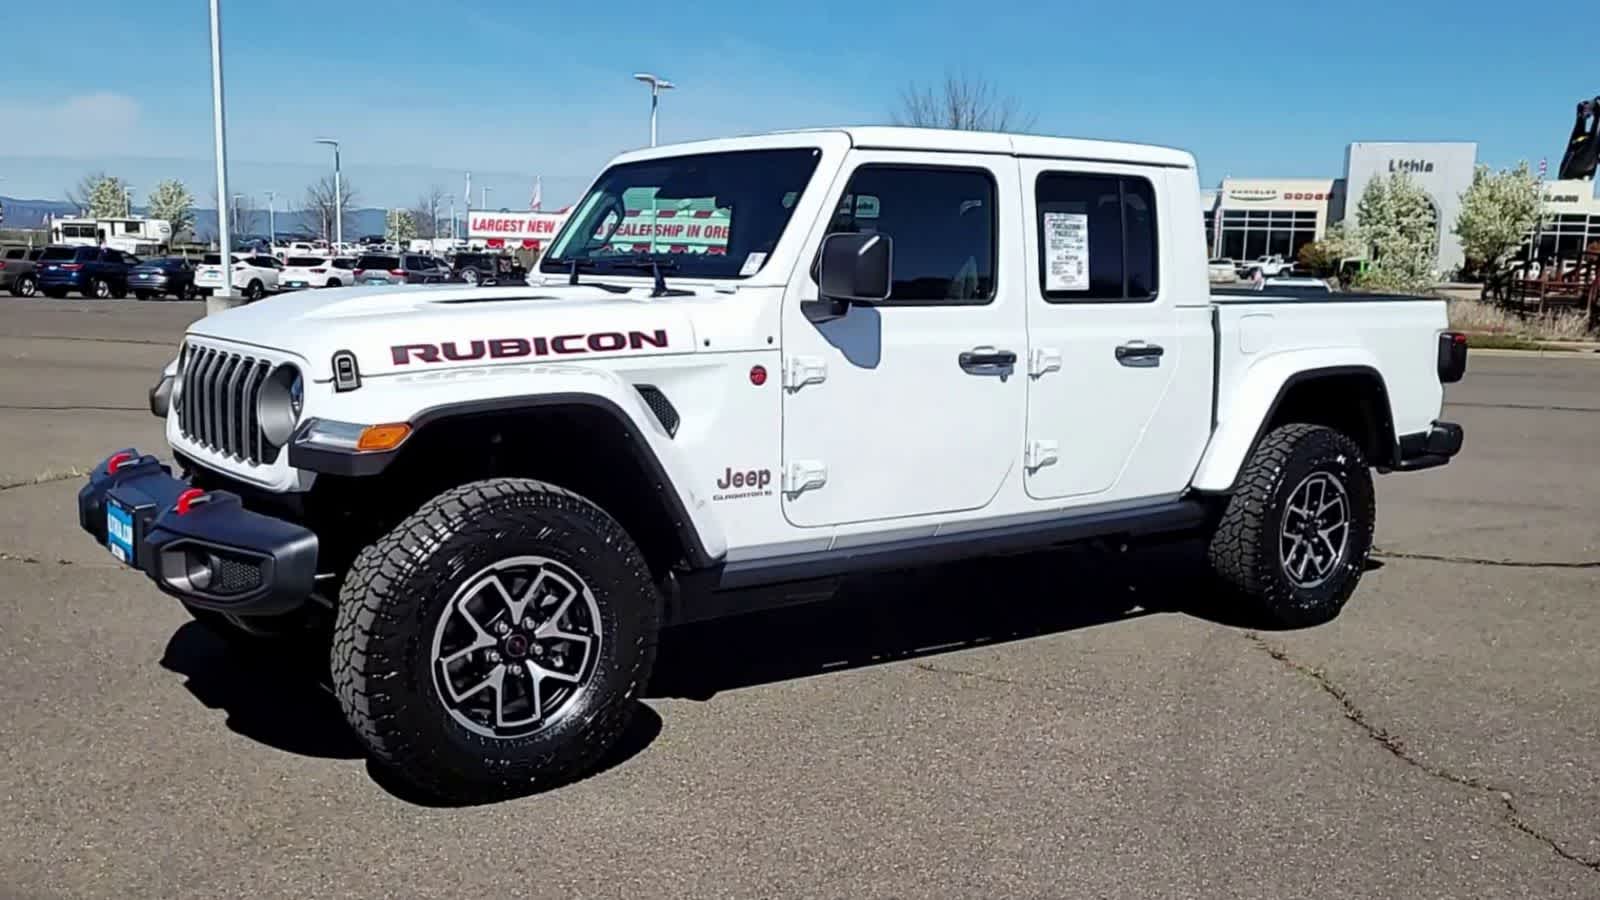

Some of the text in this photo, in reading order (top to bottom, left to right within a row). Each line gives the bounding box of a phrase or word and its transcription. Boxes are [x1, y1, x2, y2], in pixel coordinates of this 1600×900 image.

[1388, 158, 1434, 173] Lithia
[472, 218, 556, 234] LARGEST NEW
[686, 225, 701, 237] IN
[390, 329, 669, 366] RUBICON
[716, 467, 771, 490] Jeep
